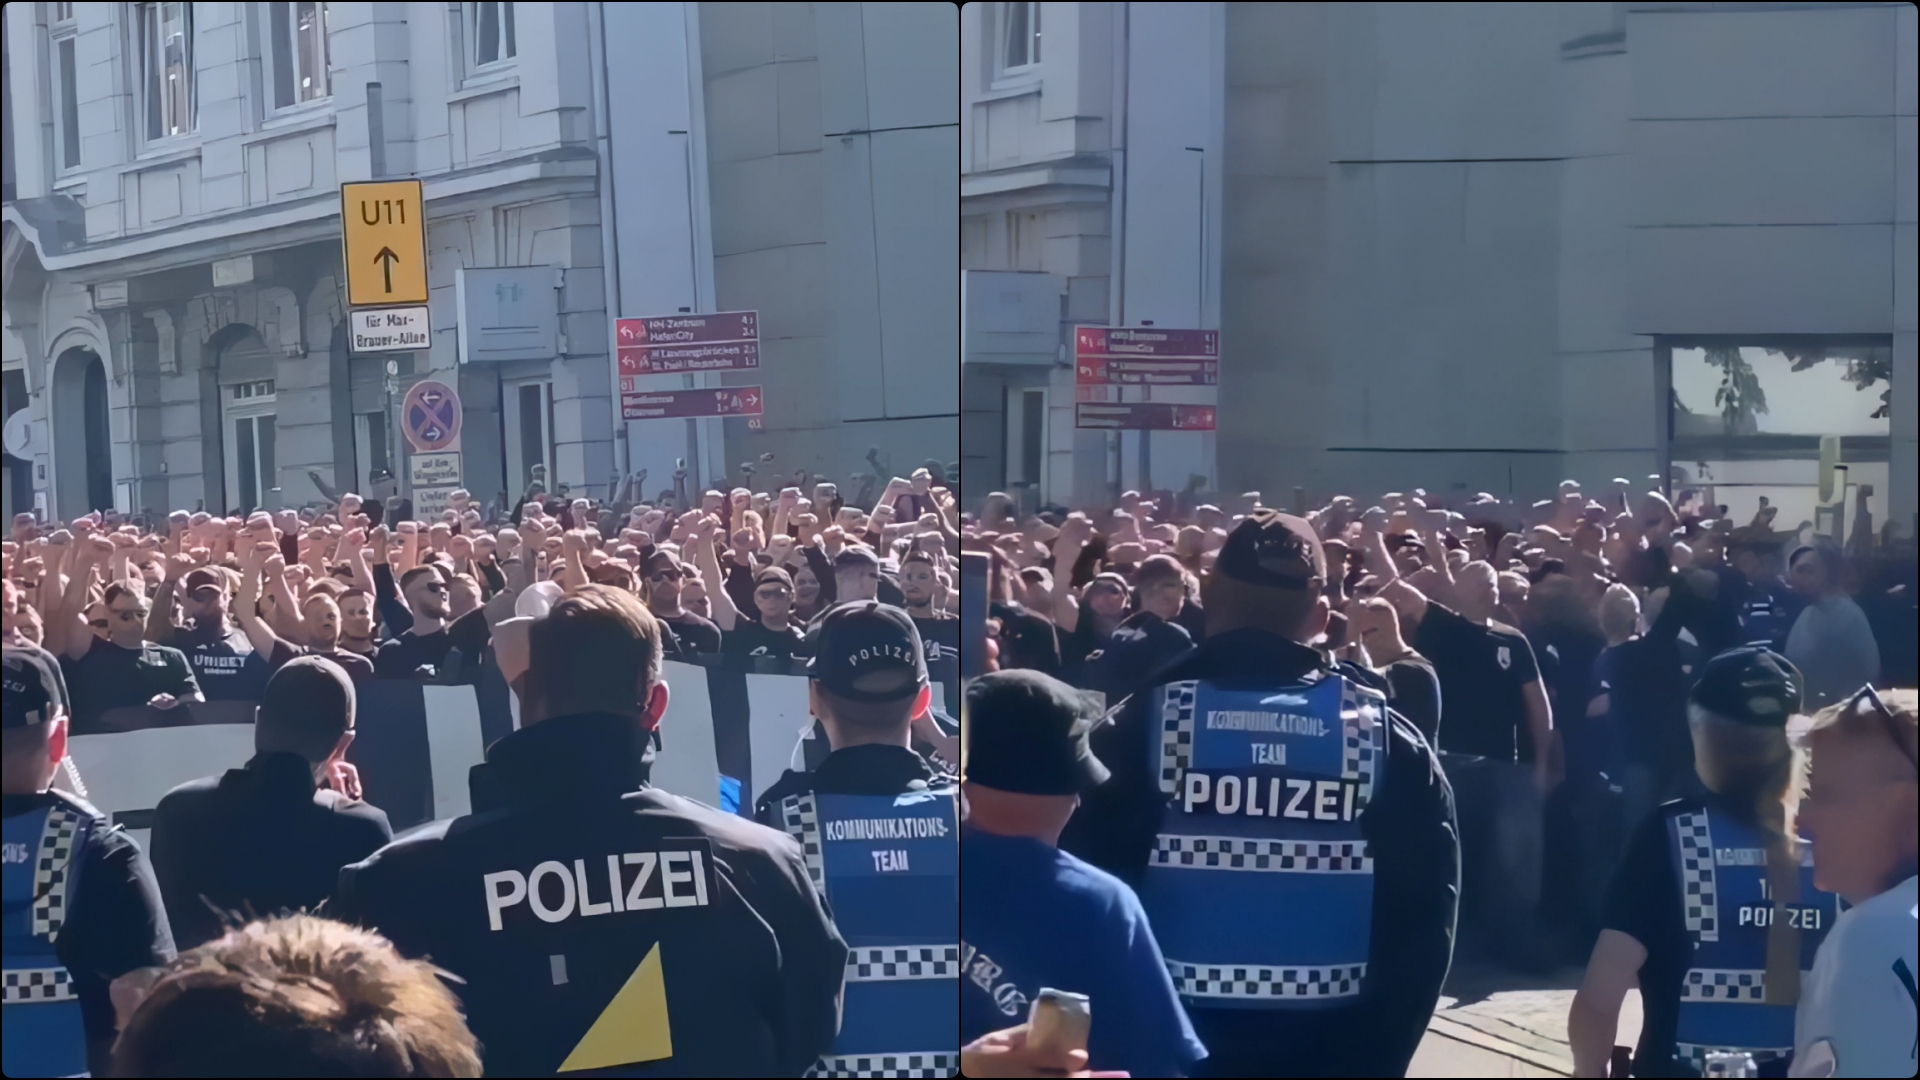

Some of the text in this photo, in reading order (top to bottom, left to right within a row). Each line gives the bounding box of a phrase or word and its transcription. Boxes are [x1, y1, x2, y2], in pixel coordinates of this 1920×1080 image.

[361, 199, 405, 226] U11
[1184, 773, 1355, 822] POLIZEI
[825, 817, 949, 840] KOMMUNIKATIONS-
[871, 850, 910, 872] TEAM
[484, 850, 709, 931] POLIZEI
[1739, 906, 1821, 929] POZEI
